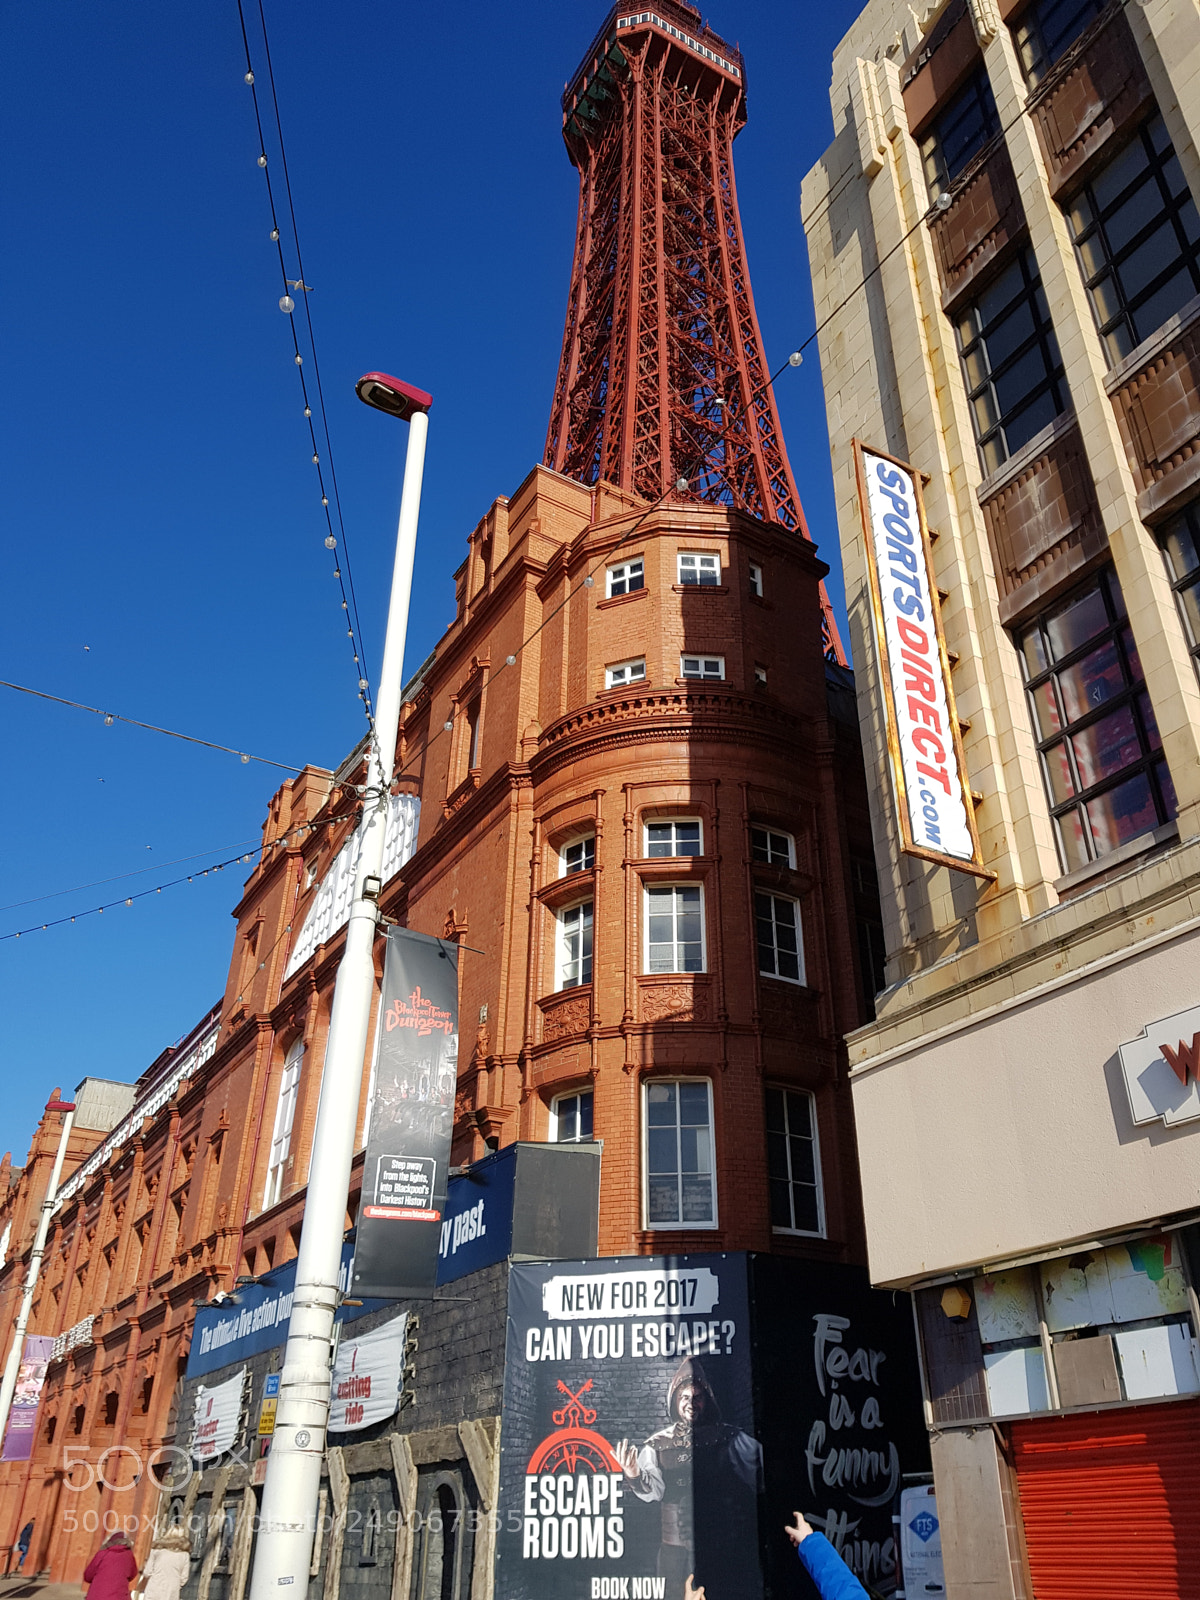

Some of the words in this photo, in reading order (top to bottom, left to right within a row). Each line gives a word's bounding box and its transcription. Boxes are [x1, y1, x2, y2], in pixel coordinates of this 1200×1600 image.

[876, 462, 951, 845] SPORTSDIRECT.COM
[409, 986, 432, 1008] the
[385, 1009, 454, 1036] Dungeon
[383, 1171, 398, 1181] from
[399, 1171, 409, 1181] the
[410, 1173, 429, 1184] lights,
[391, 1159, 406, 1170] Step
[406, 1162, 423, 1172] away
[380, 1183, 392, 1192] into
[394, 1183, 430, 1195] Blackpool's
[380, 1193, 404, 1205] Darkest
[405, 1196, 427, 1208] History
[452, 1199, 486, 1255] past.
[562, 1282, 604, 1312] NEW
[611, 1281, 647, 1310] FOR
[654, 1278, 698, 1308] 2017
[199, 1326, 213, 1355] The
[211, 1316, 240, 1350] ultimate
[238, 1308, 253, 1339] live
[252, 1297, 277, 1333] action
[275, 1291, 295, 1328] jour
[525, 1326, 572, 1362] CAN
[578, 1324, 625, 1360] YOU
[632, 1320, 736, 1357] ESCAPE?
[812, 1313, 886, 1397] Fear
[337, 1375, 371, 1400] exciting
[345, 1402, 364, 1425] ride
[829, 1379, 856, 1430] is
[861, 1397, 883, 1430] a
[805, 1420, 900, 1507] funny
[524, 1474, 624, 1516] ESCAPE
[523, 1516, 624, 1559] ROOMS
[916, 1517, 933, 1531] FTS
[591, 1577, 630, 1600] BOOK
[632, 1577, 666, 1600] NOW
